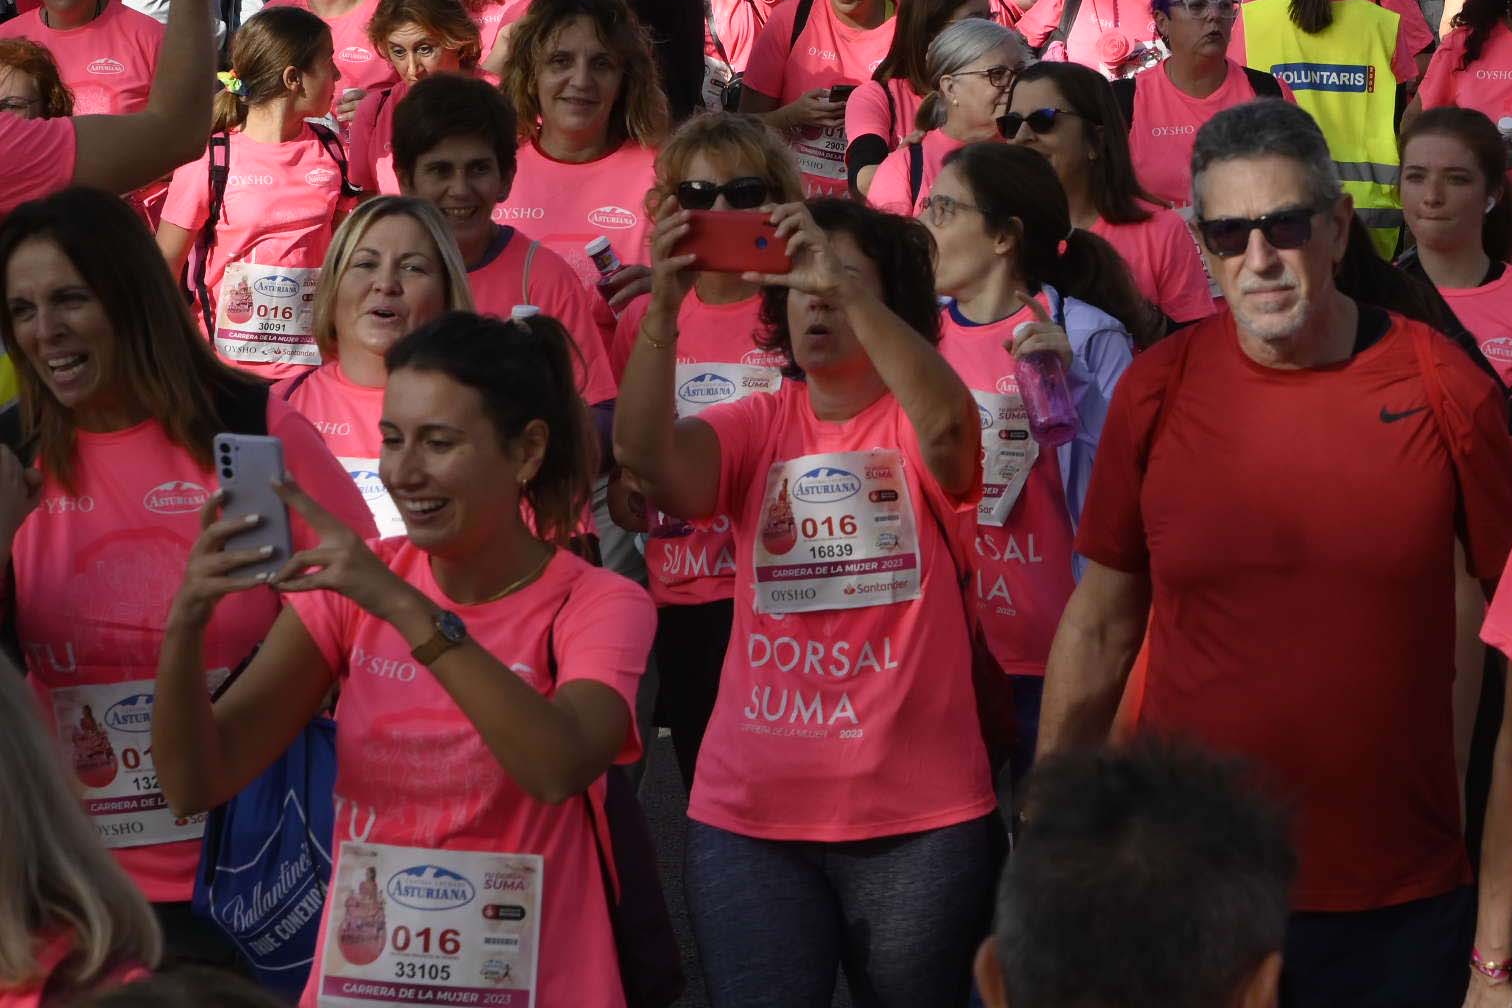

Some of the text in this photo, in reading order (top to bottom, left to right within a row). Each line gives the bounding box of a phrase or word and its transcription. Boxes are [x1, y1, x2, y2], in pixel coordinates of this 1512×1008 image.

[1151, 124, 1195, 137] OYSHO
[492, 207, 545, 221] OYSHO
[257, 304, 293, 320] 016
[229, 331, 258, 340] CARRERA
[258, 322, 287, 333] 30091
[224, 344, 257, 355] OYSHO
[282, 348, 316, 358] Santander
[683, 385, 731, 398] ASTURIANA
[796, 481, 856, 497] ASTURIANA
[801, 514, 858, 539] 016
[809, 543, 853, 559] 16839
[662, 543, 736, 578] SUMA
[772, 558, 904, 578] CARRERA DE LA MUJER 2023
[857, 578, 909, 594] Santander
[771, 587, 817, 602] OYSHO
[747, 633, 899, 677] DORSAL
[744, 685, 860, 726] SUMA
[839, 728, 864, 739] 2023
[91, 798, 155, 813] CARRERA DE
[394, 880, 467, 901] ASTURIANA
[483, 879, 526, 891] SUMA
[391, 925, 461, 955] 016
[395, 962, 450, 980] 33105
[342, 983, 512, 1005] CARRERA DE LA MUJER 2023
